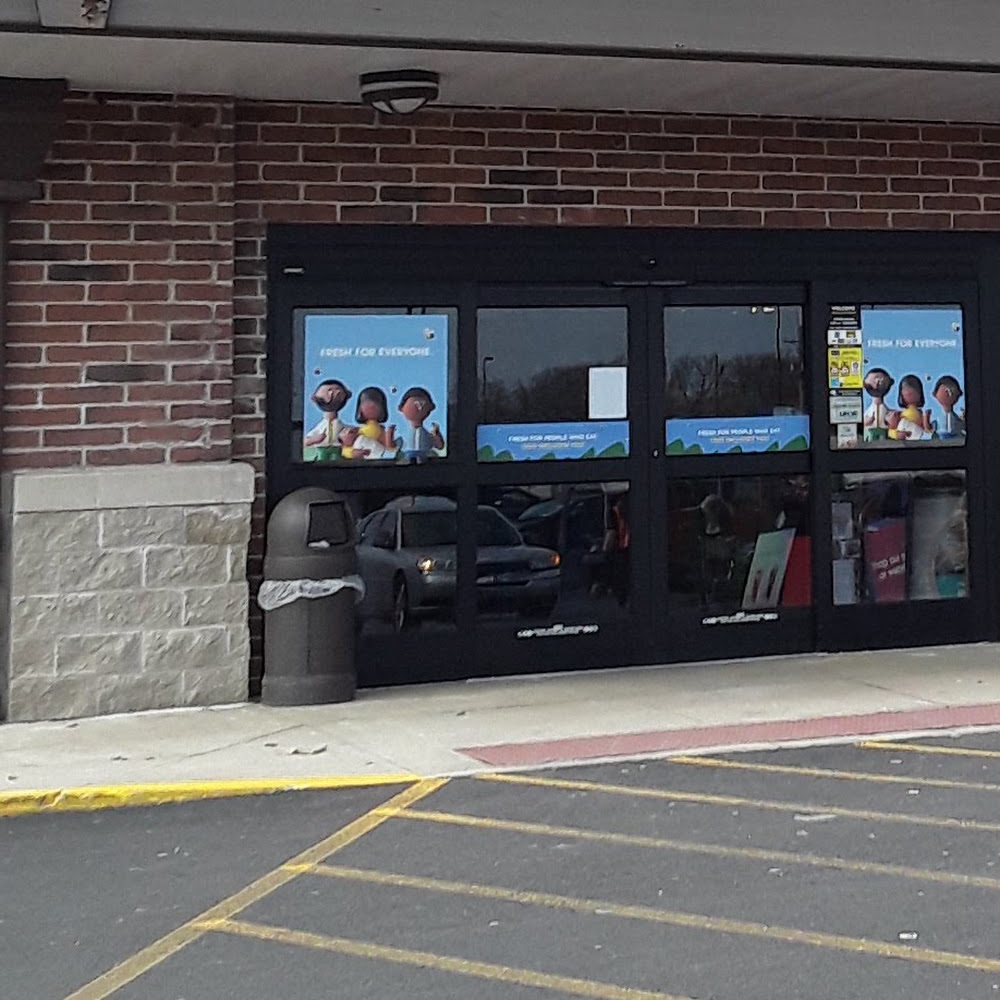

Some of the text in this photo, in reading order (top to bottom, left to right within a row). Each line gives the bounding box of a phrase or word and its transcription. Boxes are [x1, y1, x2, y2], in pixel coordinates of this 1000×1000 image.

[866, 339, 957, 348] FRESH FOR EVERYONE
[320, 346, 431, 357] FRESH FOR EVERYONE
